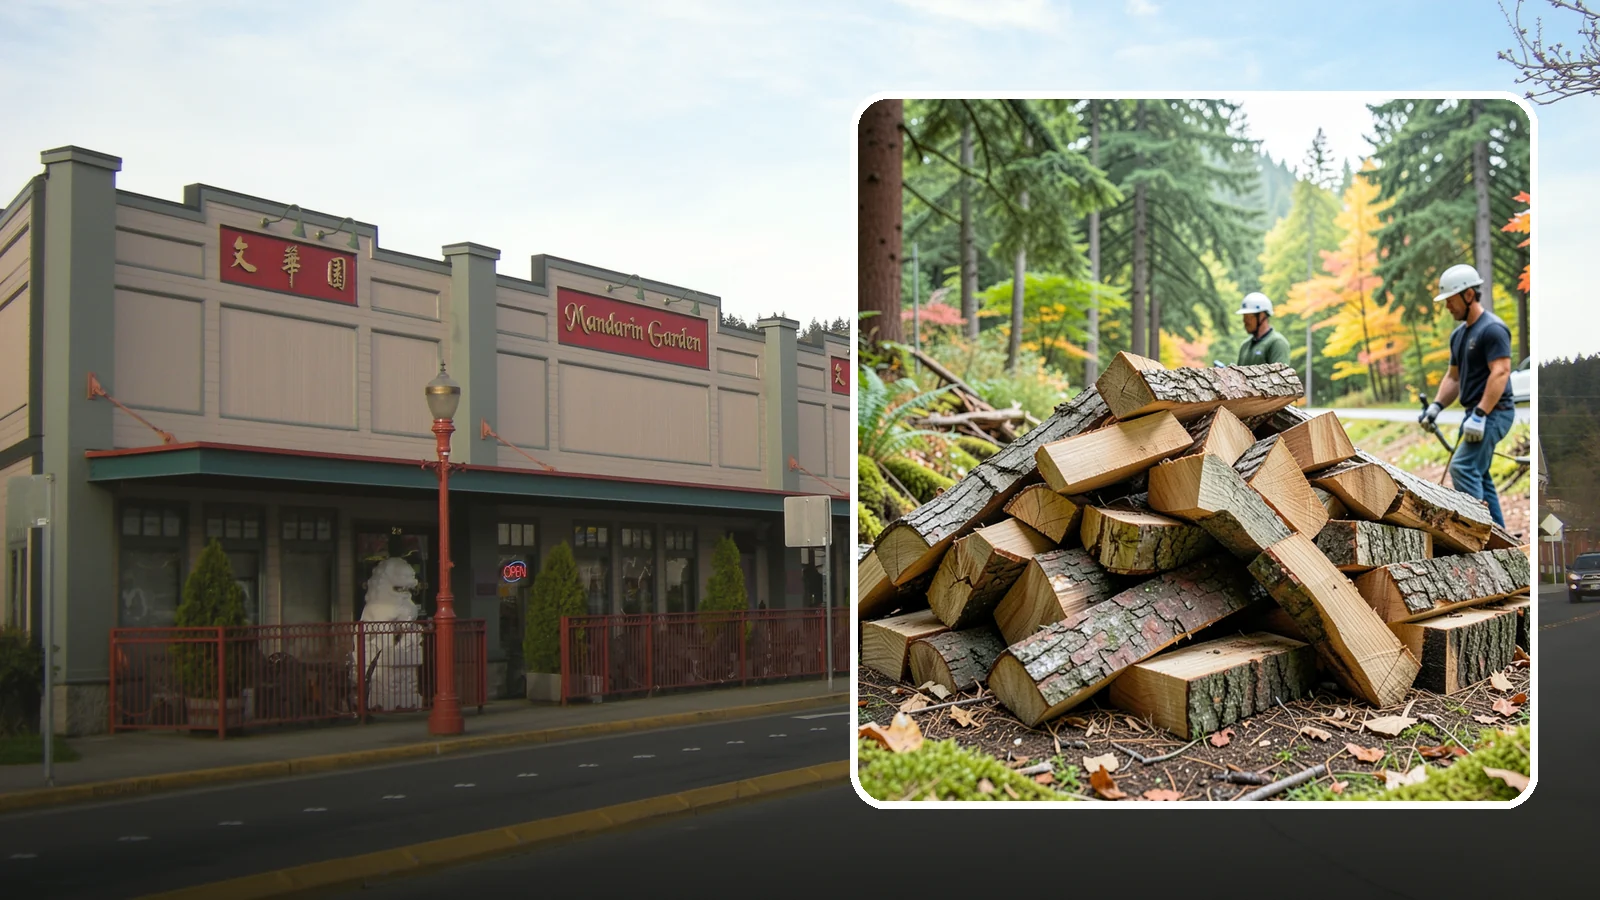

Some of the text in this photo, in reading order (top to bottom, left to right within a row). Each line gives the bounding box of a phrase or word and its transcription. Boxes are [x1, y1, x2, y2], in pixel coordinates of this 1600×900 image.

[231, 235, 346, 291] 文華園
[564, 302, 702, 352] Mandarin Garden
[503, 565, 527, 578] OPEN
